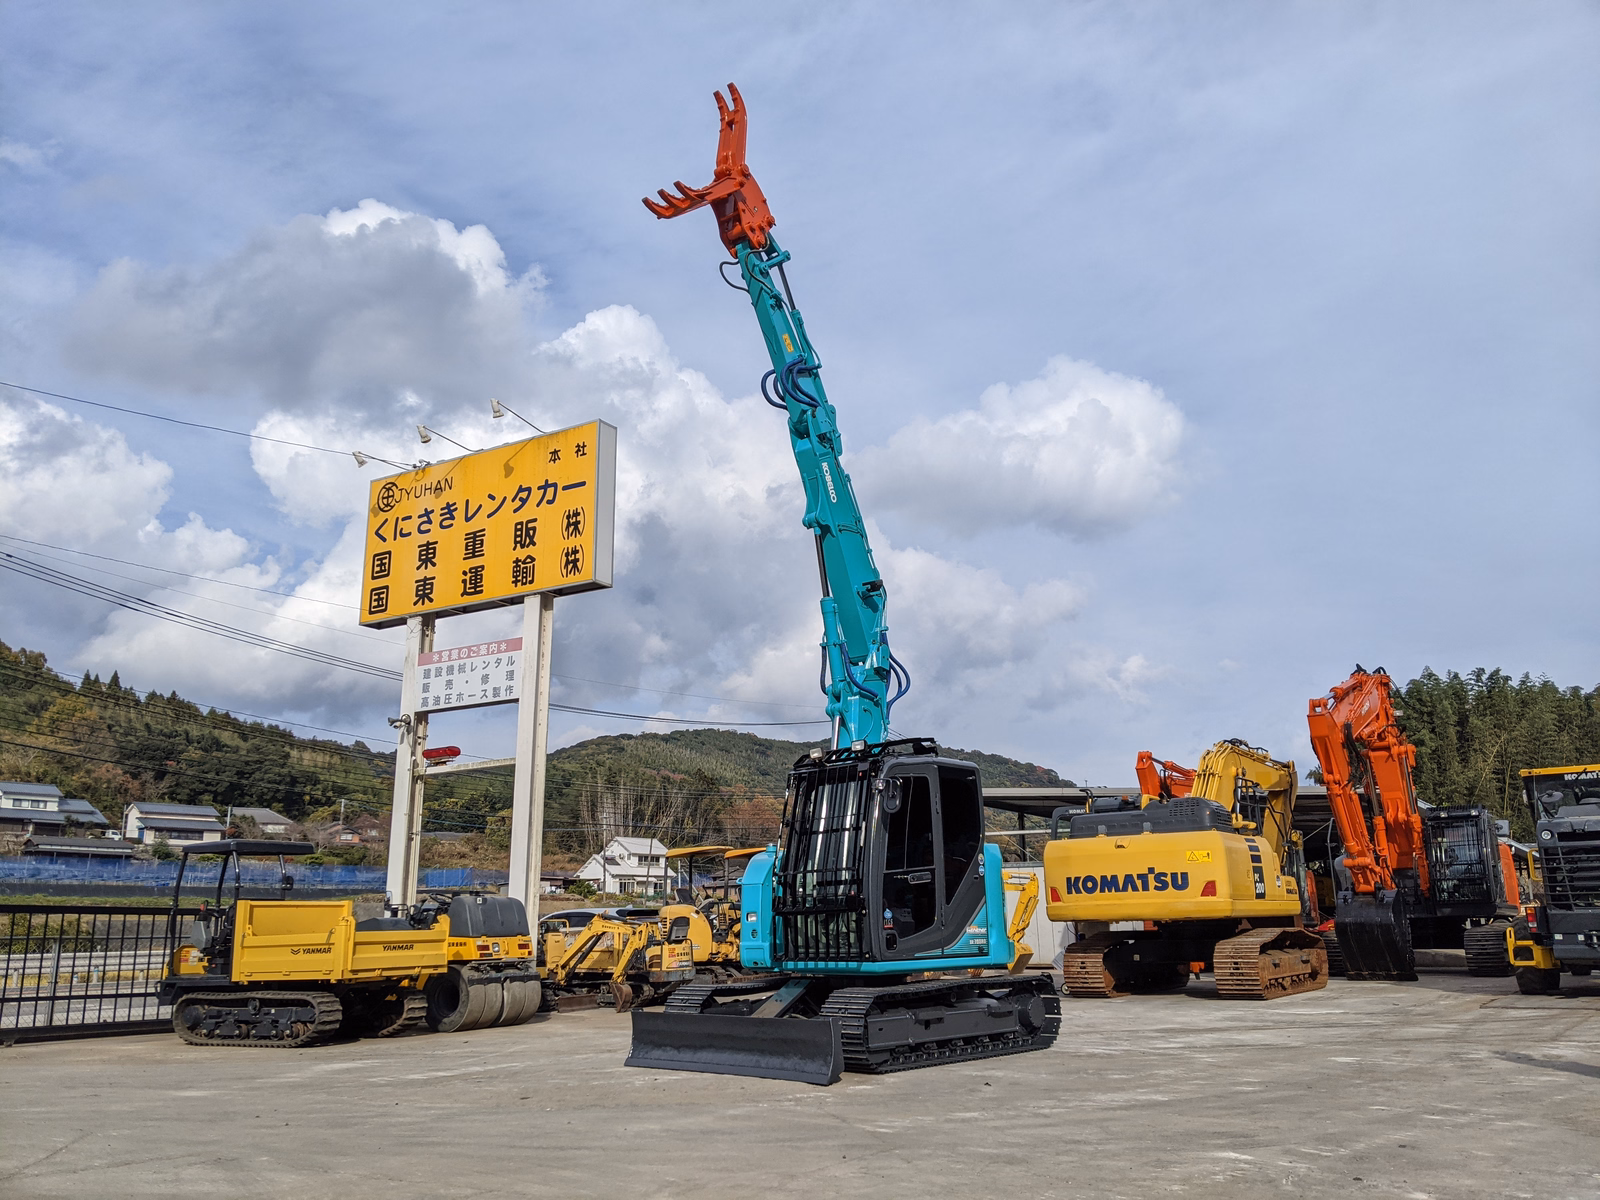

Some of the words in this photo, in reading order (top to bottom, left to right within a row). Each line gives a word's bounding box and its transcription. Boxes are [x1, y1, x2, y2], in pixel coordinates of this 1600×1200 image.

[548, 441, 587, 465] 本社
[821, 462, 837, 503] KOBELCO
[374, 479, 587, 543] くにさきレンタカー
[422, 655, 516, 680] 建設機械レンタル
[420, 684, 514, 709] 高油圧ホース製作
[1066, 867, 1190, 895] KOMATSU
[1254, 873, 1260, 882] PC
[1255, 882, 1265, 894] 200
[302, 947, 332, 955] YANMAR
[382, 944, 414, 952] YANMAR
